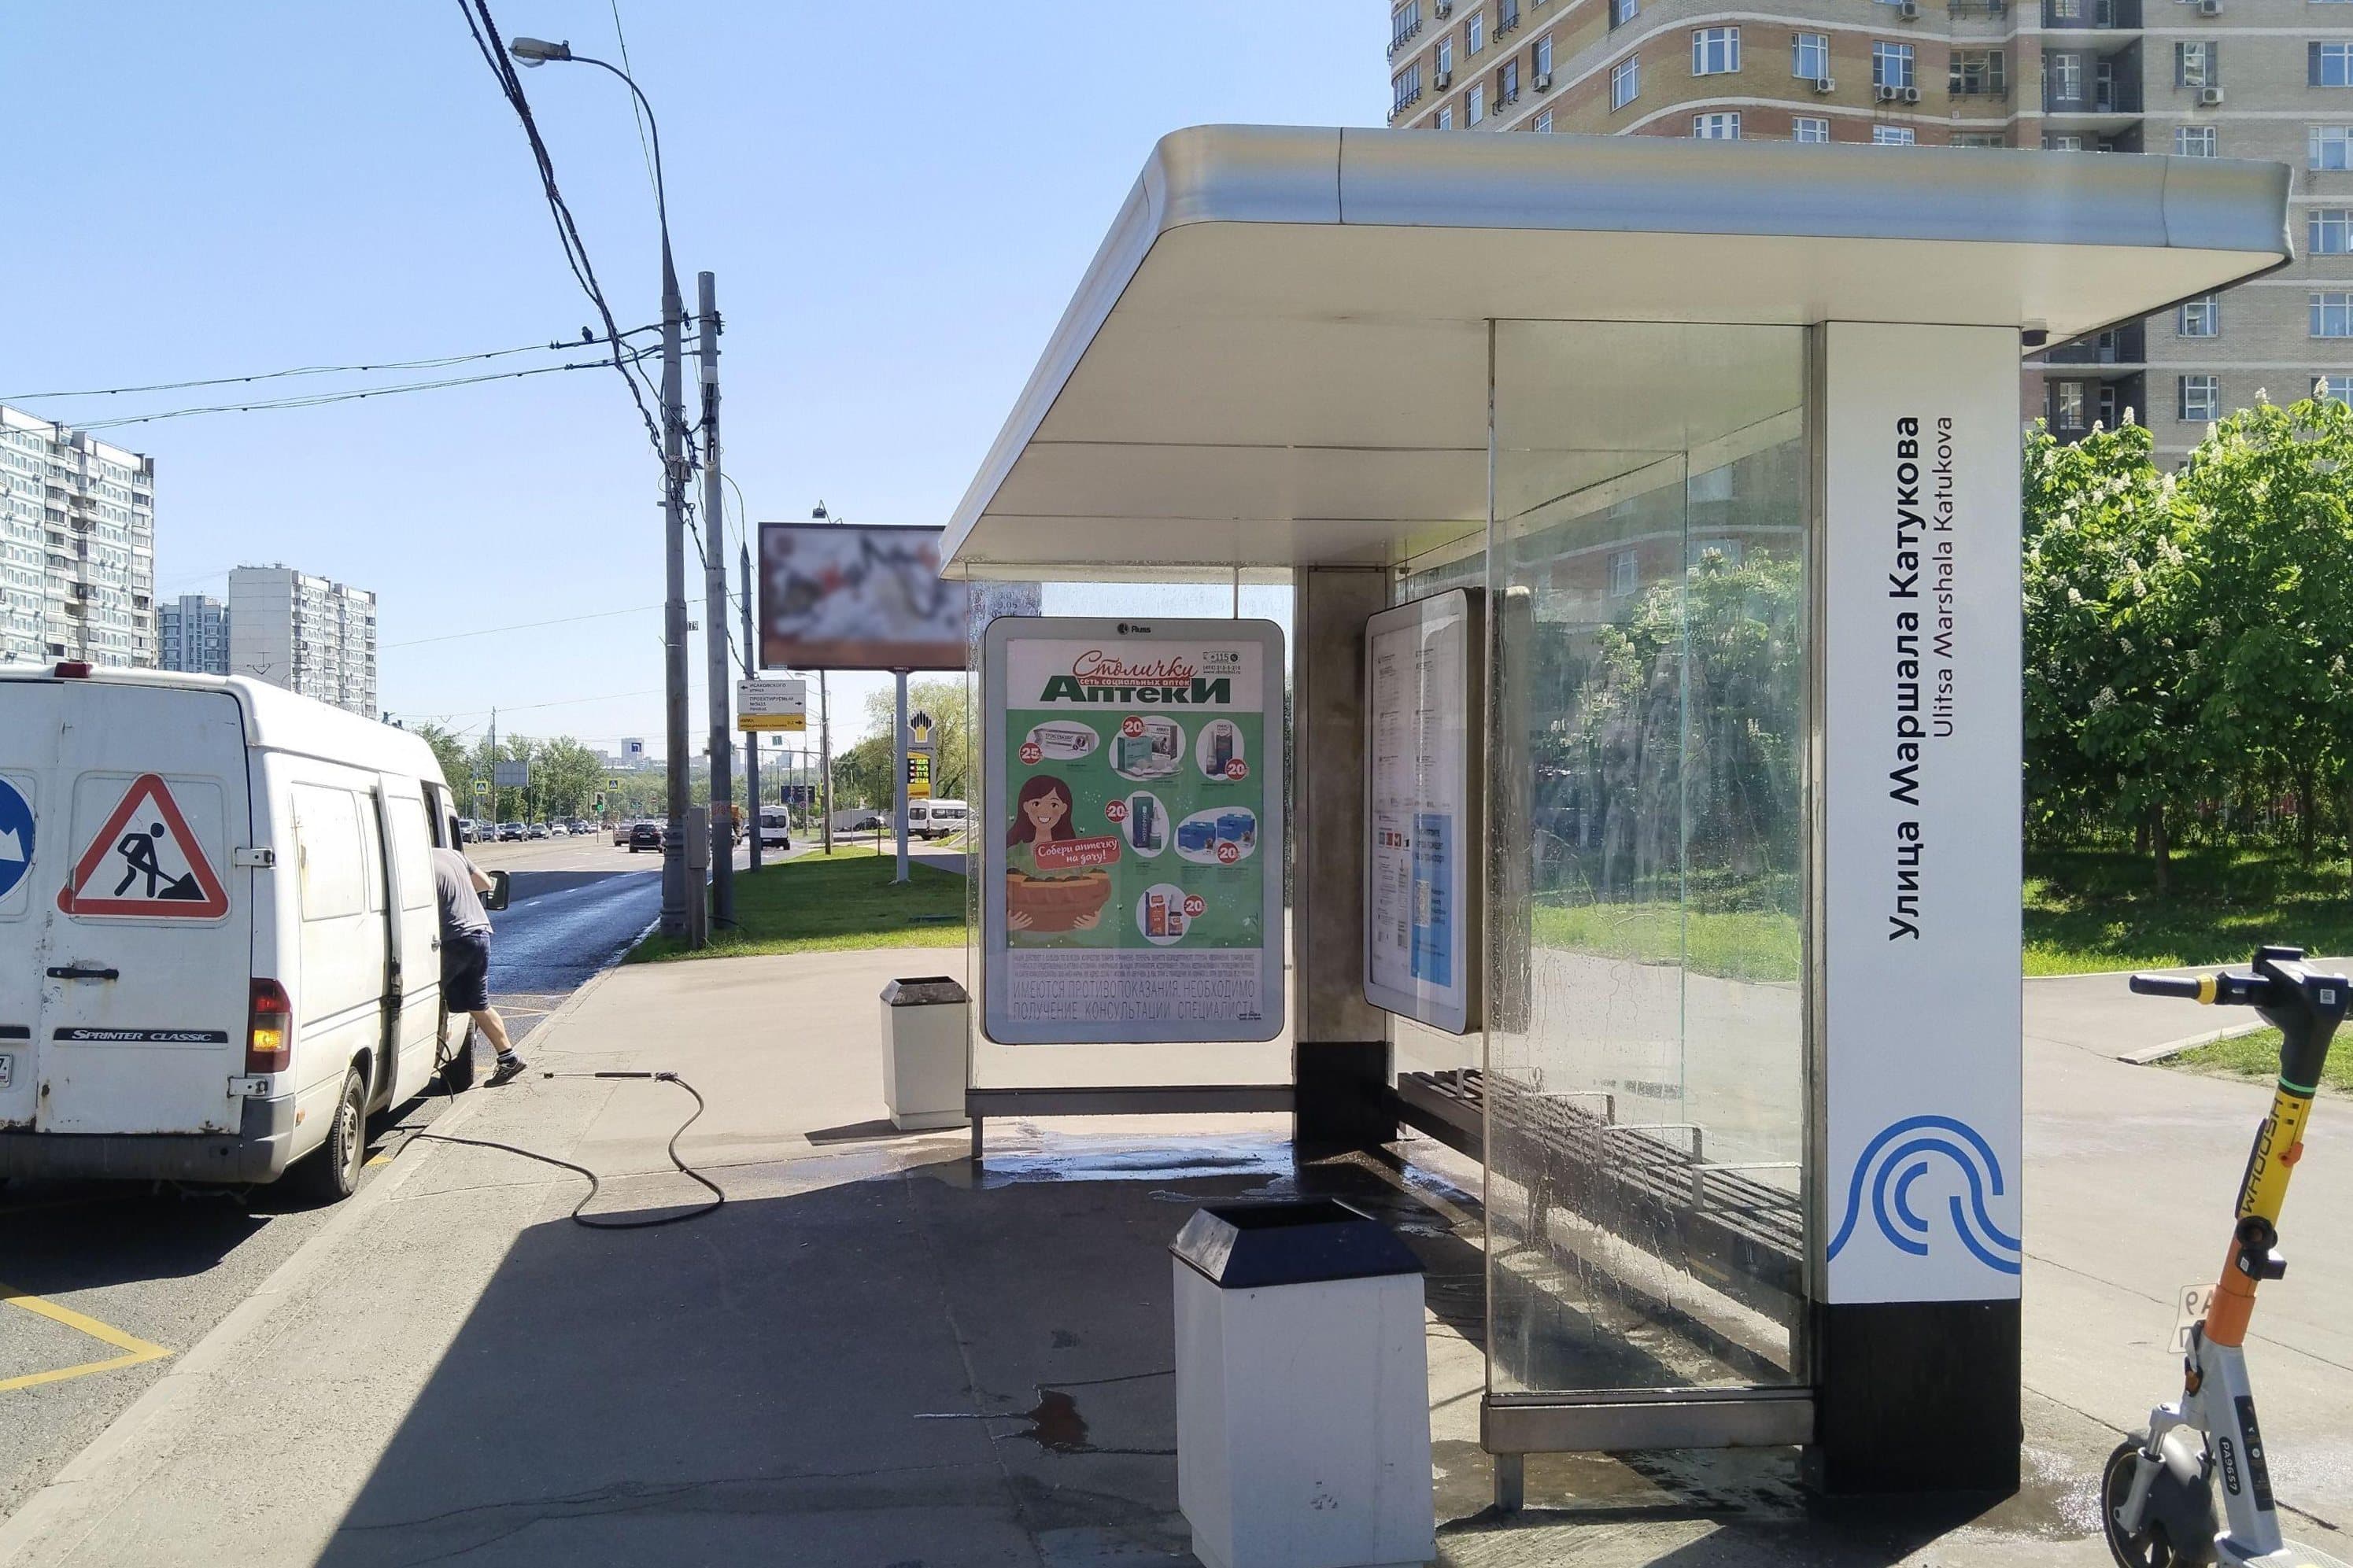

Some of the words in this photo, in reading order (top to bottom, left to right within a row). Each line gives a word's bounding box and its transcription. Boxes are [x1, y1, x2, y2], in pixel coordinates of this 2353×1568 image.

[1932, 417, 1953, 531] Katukova
[1889, 416, 1926, 598] Катукова
[1932, 541, 1953, 659] Marshala
[1072, 649, 1199, 677] Столички
[1889, 611, 1926, 806] Маршала
[1932, 668, 1953, 737] Ulitsa
[1038, 844, 1073, 857] Собери
[1074, 839, 1117, 850] аптечку
[1066, 854, 1078, 863] на
[1080, 849, 1107, 865] дачу!
[1889, 821, 1924, 941] Улица
[1013, 1002, 1078, 1020] ПОЛУЧЕНИЕ
[1085, 1002, 1170, 1020] КОНСУЛЬТАЦИИ
[1177, 1001, 1254, 1020] СПЕЦИАЛИСТА
[1014, 980, 1065, 998] ИМЕЮТСЯ
[1183, 980, 1255, 999] НЕОБХОДИМО
[150, 1031, 212, 1042] CLASSIC
[2242, 1097, 2284, 1213] WHOOSH
[2222, 1441, 2238, 1491] PA9657
